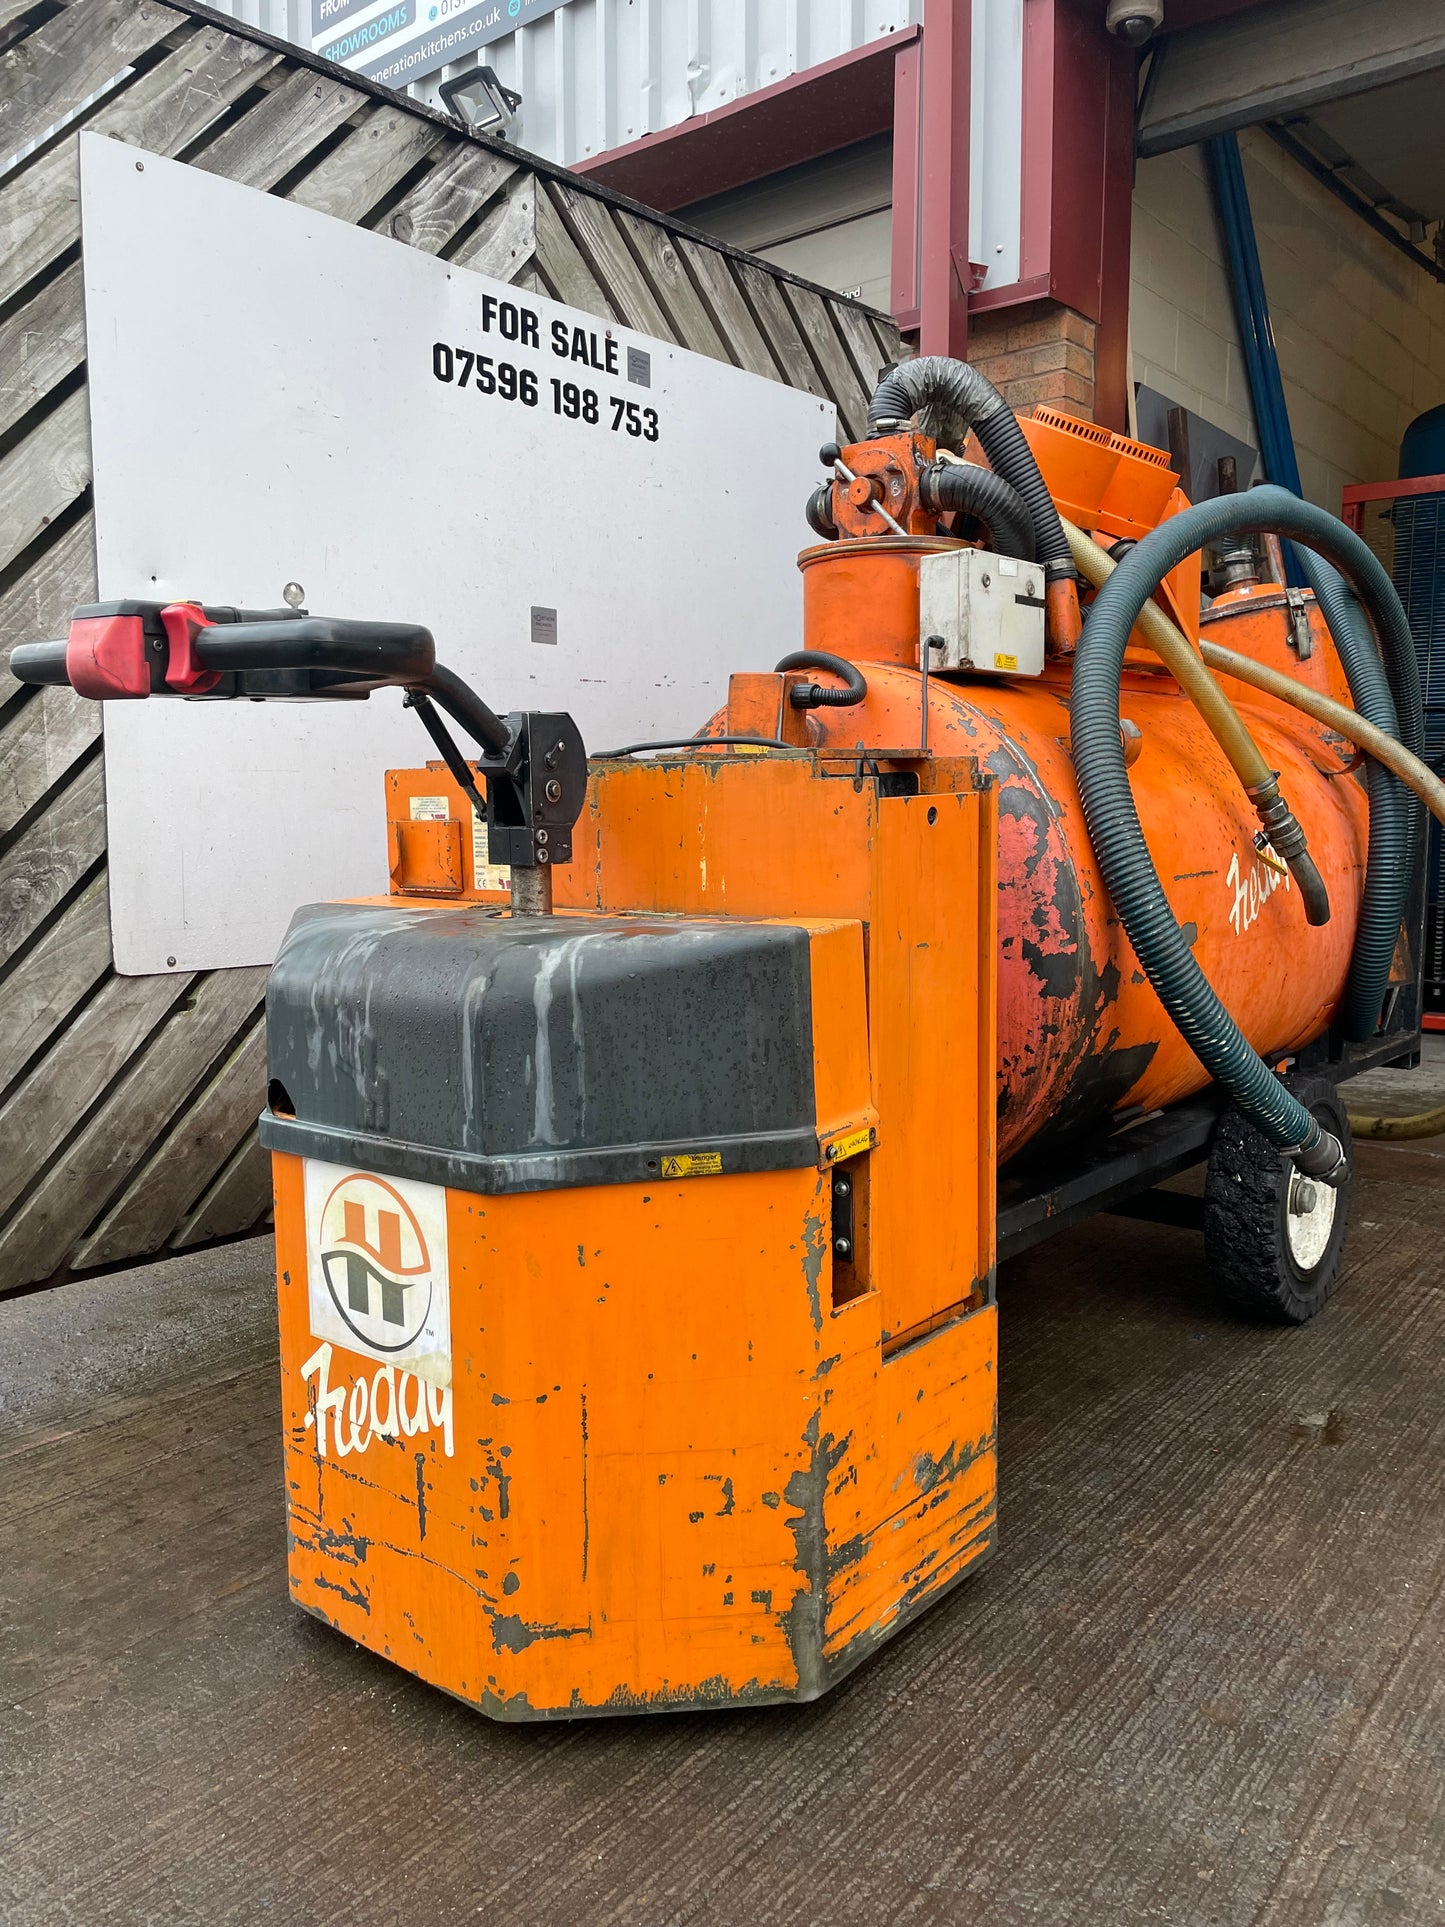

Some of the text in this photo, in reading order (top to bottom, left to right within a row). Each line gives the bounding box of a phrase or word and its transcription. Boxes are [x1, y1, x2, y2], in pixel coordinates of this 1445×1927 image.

[325, 6, 408, 61] SHOWROOMS
[368, 7, 501, 83] enerationkitchens.co.uk
[482, 294, 540, 349] FOR
[551, 319, 619, 375] SALE
[432, 342, 659, 443] 07596 198 753
